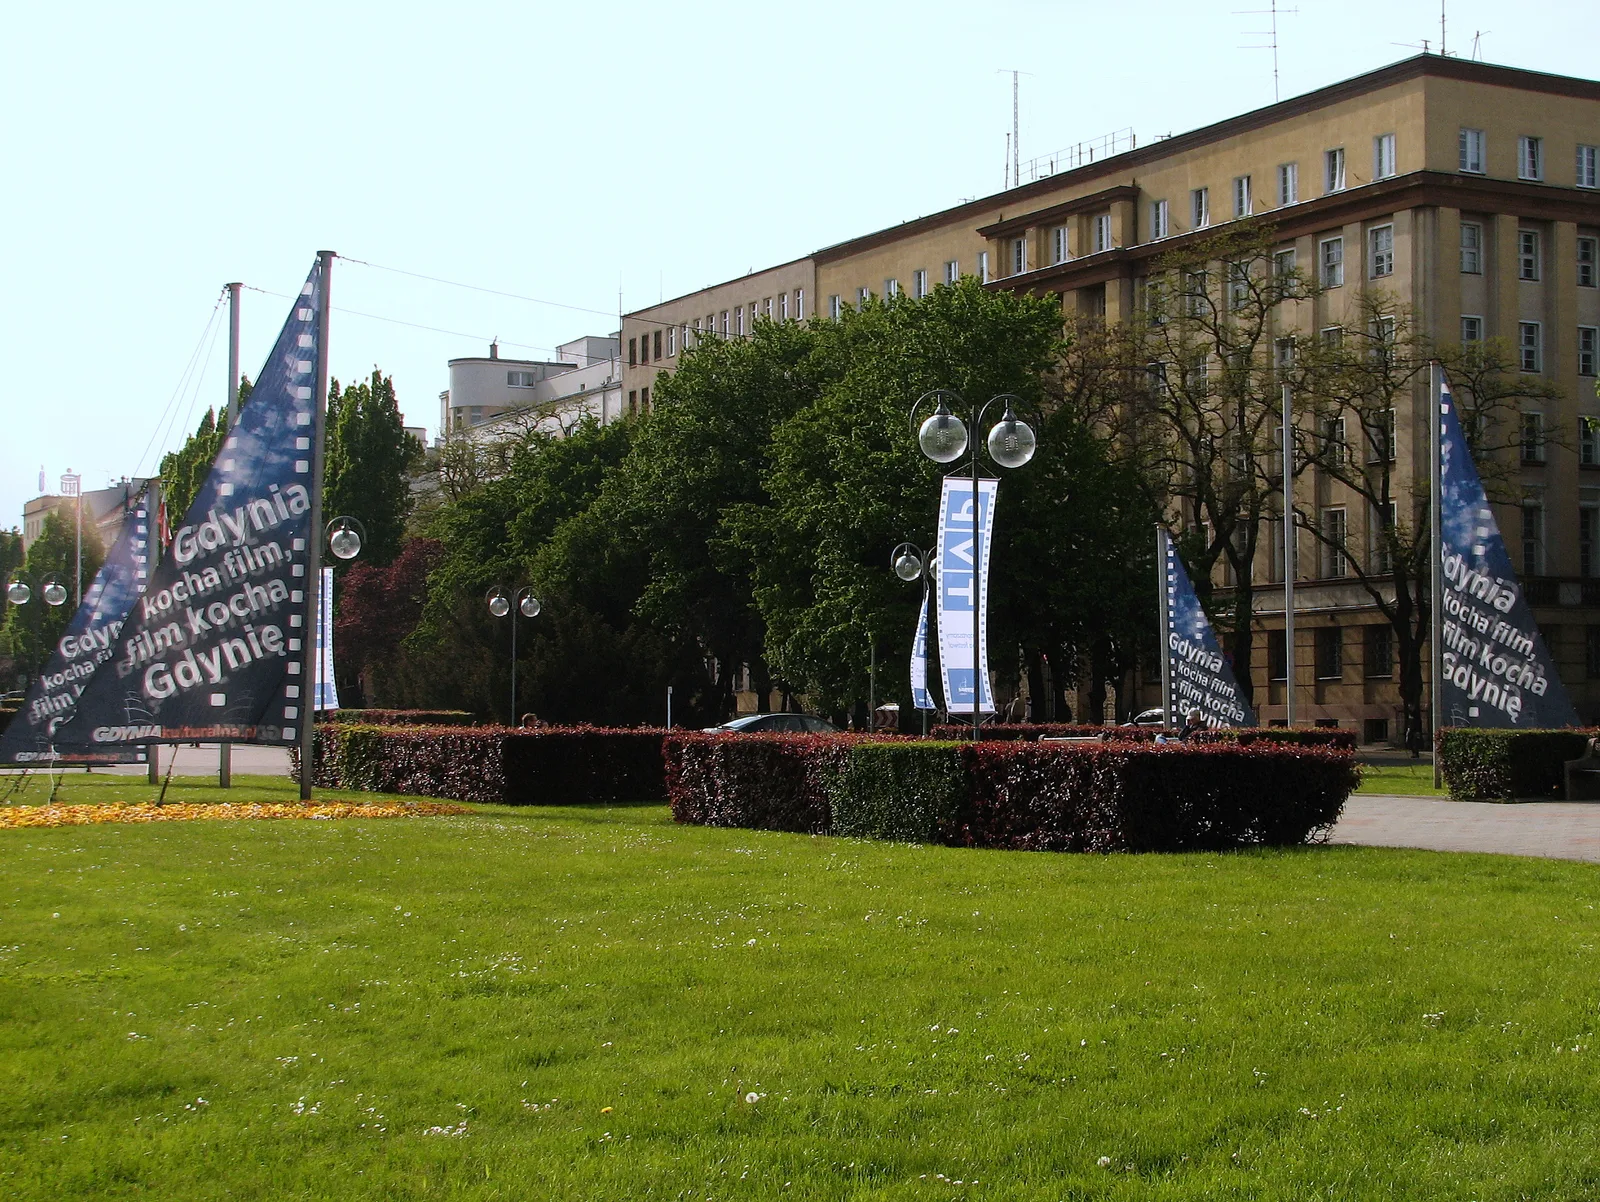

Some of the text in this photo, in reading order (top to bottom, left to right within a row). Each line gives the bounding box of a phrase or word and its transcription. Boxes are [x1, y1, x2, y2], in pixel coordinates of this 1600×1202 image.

[173, 483, 312, 563] Gdynia
[142, 540, 293, 621] kocha film,
[1441, 541, 1516, 614] dynia
[60, 612, 128, 658] Gdyn
[126, 619, 183, 667] film
[186, 578, 289, 636] kocha
[1169, 632, 1223, 673] Gdynia
[1442, 620, 1548, 697] film kocha
[1443, 587, 1536, 662] kocha film,
[41, 660, 96, 690] kocha
[144, 624, 287, 700] Gdynię
[1177, 660, 1237, 702] kocha film,
[31, 692, 75, 719] film
[1179, 680, 1245, 722] film kocha
